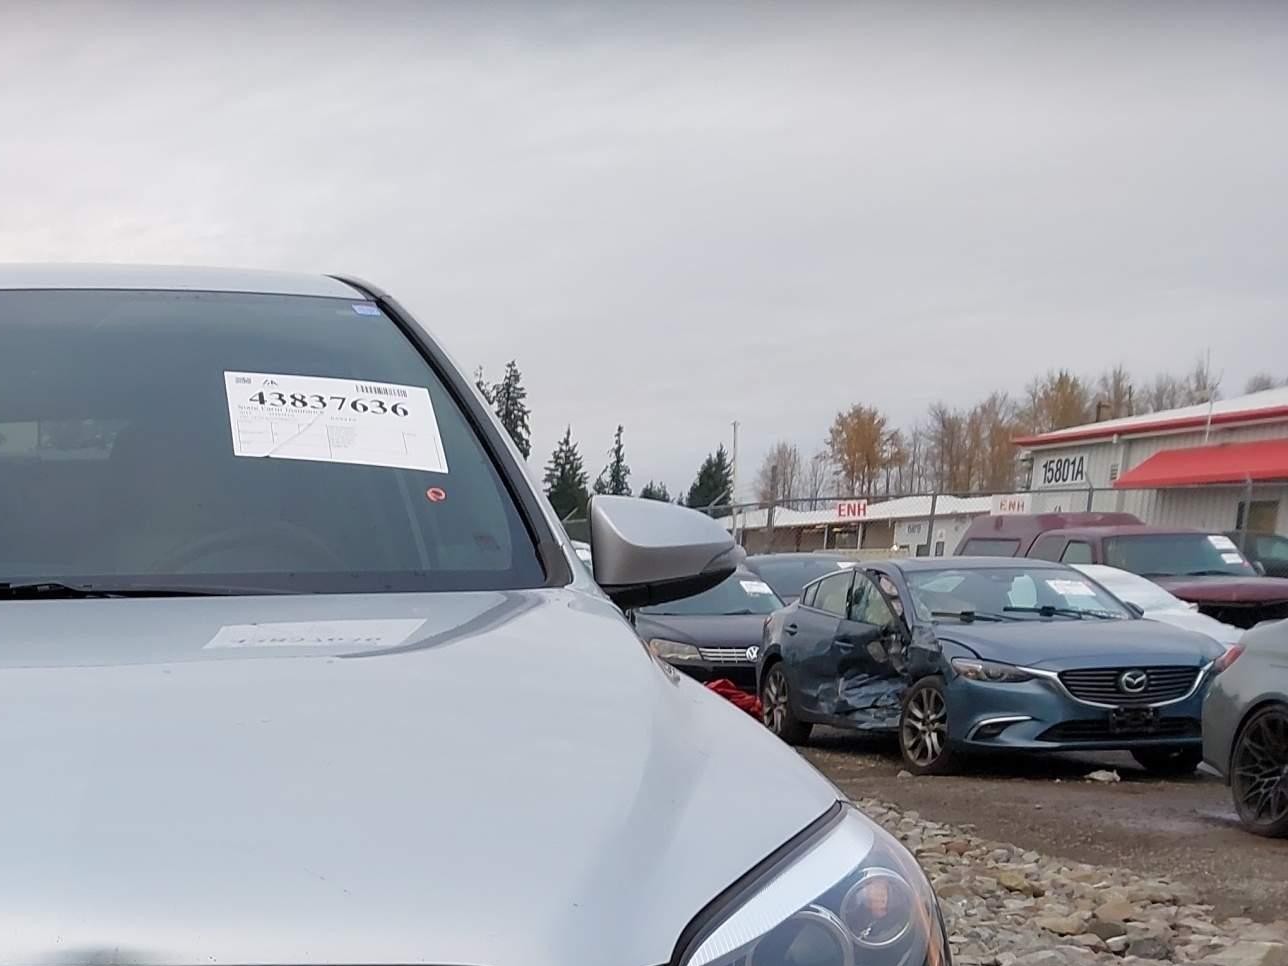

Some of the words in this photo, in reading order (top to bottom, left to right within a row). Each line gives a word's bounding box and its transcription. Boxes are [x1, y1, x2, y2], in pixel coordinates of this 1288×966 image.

[249, 391, 409, 417] 43837636
[1042, 456, 1085, 484] 15801A
[838, 503, 867, 517] ENH
[999, 499, 1025, 512] ENH
